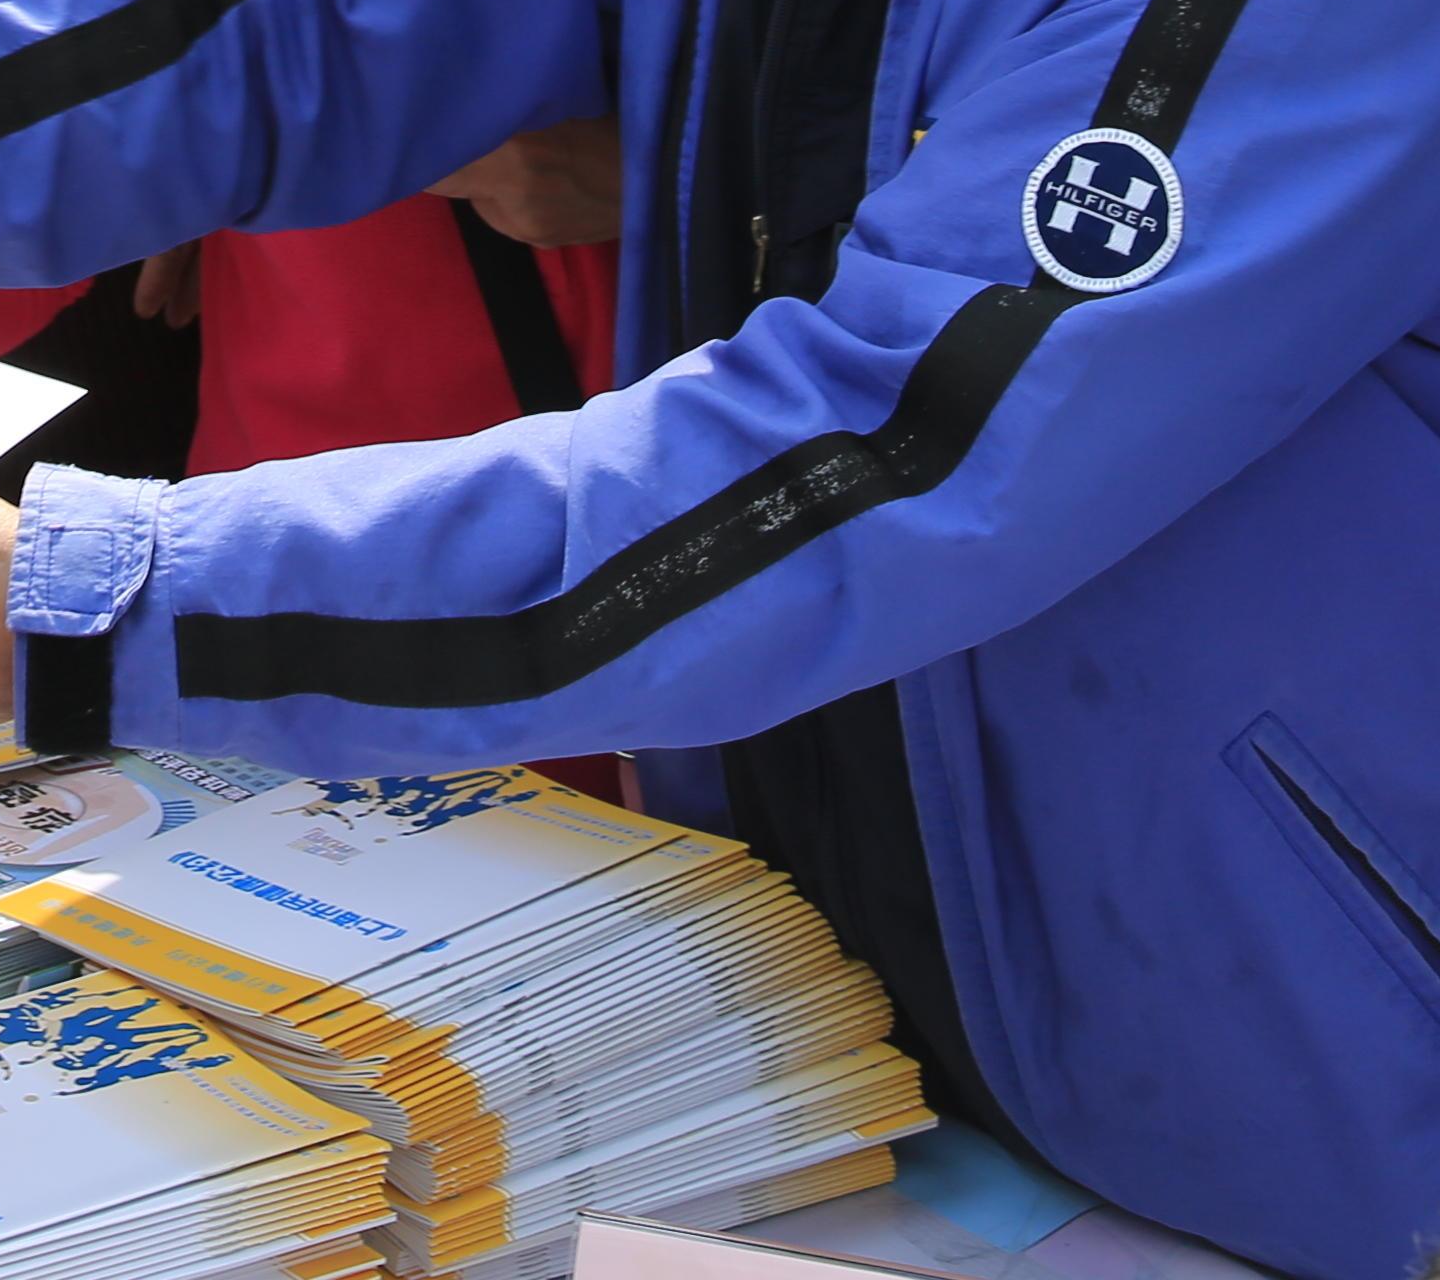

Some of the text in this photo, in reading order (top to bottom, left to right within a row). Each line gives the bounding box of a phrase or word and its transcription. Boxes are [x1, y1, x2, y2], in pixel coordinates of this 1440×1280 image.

[1045, 181, 1159, 233] HILFIGER
[166, 849, 410, 943] 《上海市民健康公约》
